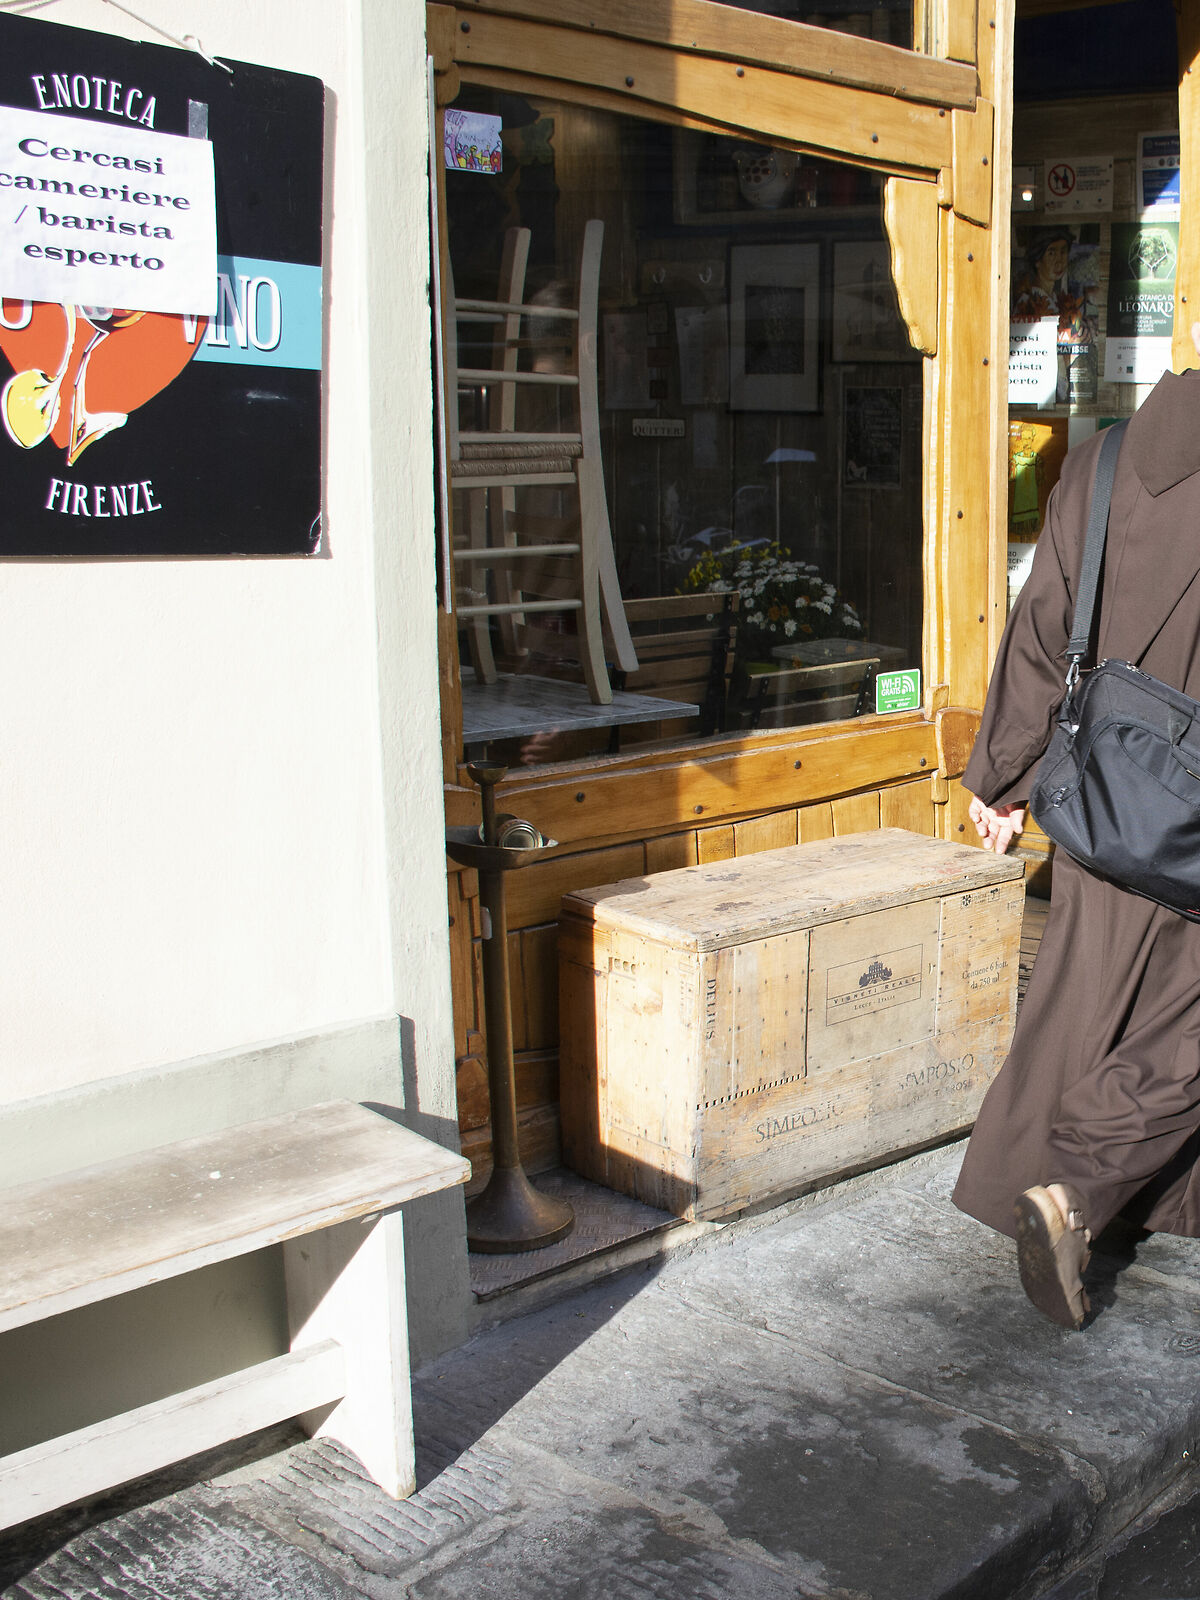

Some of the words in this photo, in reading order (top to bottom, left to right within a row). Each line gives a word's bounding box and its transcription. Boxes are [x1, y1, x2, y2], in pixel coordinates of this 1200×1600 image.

[31, 73, 157, 129] ENOTECA
[18, 138, 166, 175] Cercasi
[0, 172, 192, 210] cameriere
[36, 206, 175, 240] barista
[23, 243, 165, 270] esperto
[1119, 301, 1174, 318] LEONARD
[1009, 333, 1040, 342] rcasi
[1057, 345, 1089, 354] MATISSE
[1009, 347, 1048, 357] eriere
[45, 478, 163, 517] FIRENZE
[881, 677, 902, 689] WI-FI
[881, 687, 901, 696] GRATIS
[834, 988, 877, 1004] VIGNETI
[884, 977, 916, 990] REALE
